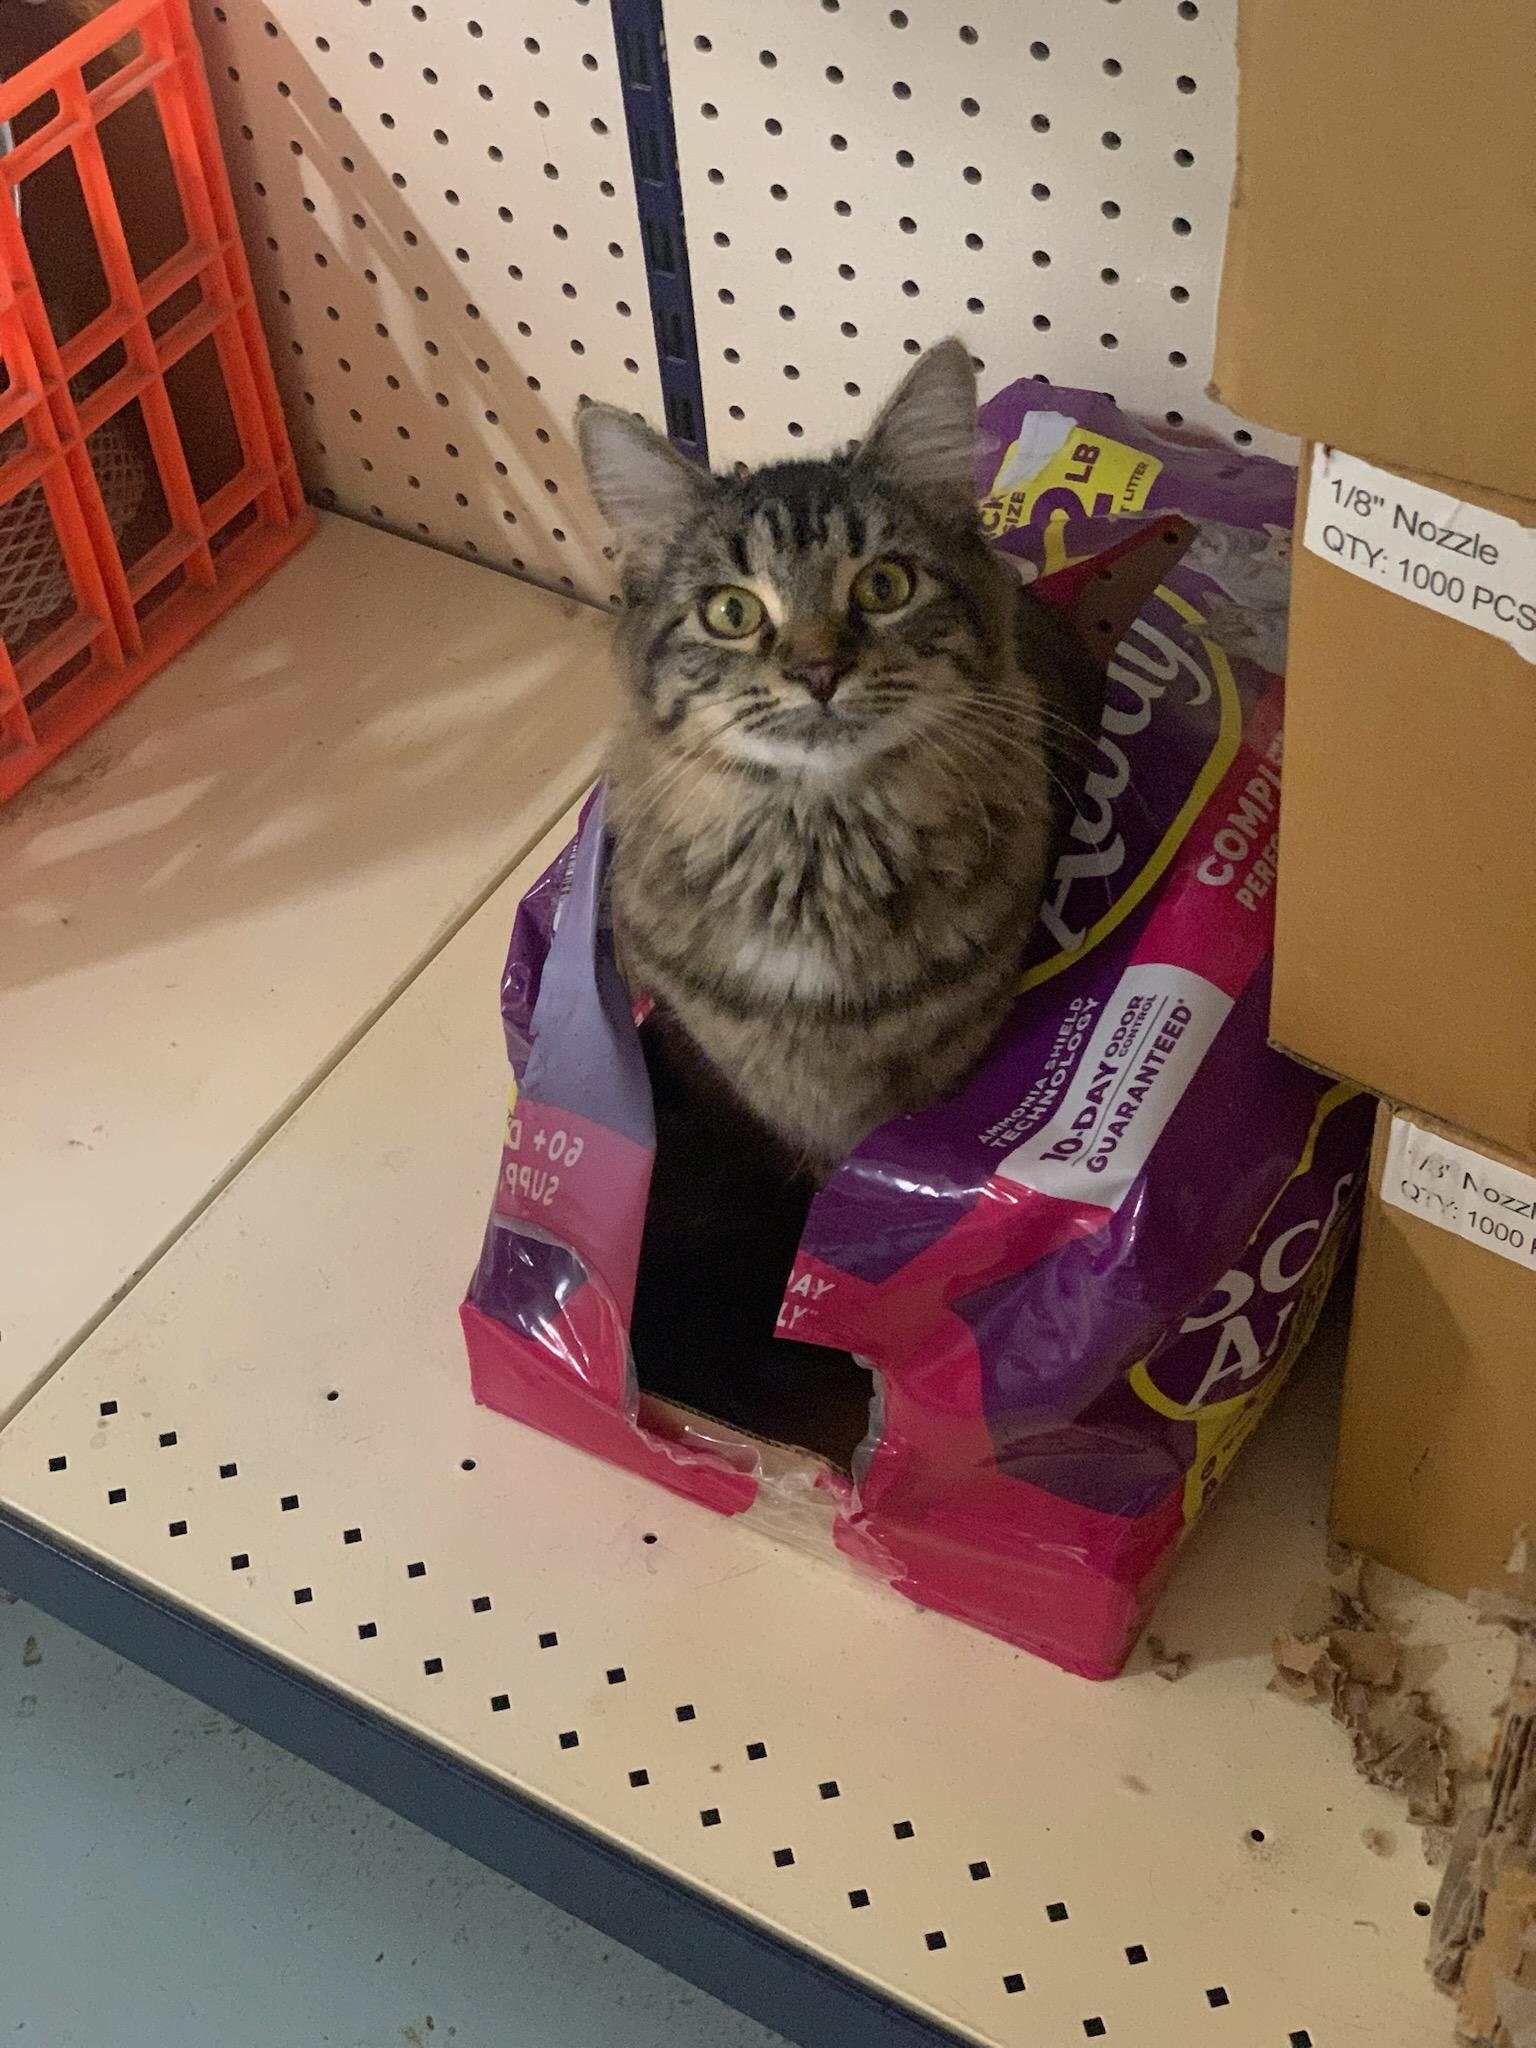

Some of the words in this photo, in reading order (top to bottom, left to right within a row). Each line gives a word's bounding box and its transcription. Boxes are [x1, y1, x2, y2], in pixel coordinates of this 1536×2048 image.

[1064, 443, 1101, 484] LB
[1123, 461, 1150, 502] LITTER
[1331, 478, 1385, 517] 1/8"
[1392, 503, 1499, 566] Nozzle
[1322, 524, 1388, 575] QTY:
[1398, 558, 1465, 604] 1000
[1472, 585, 1536, 632] PCS
[1118, 994, 1158, 1058] CONTROL
[977, 1077, 1047, 1144] AMMONIA
[1044, 997, 1084, 1071] SHIELD
[990, 997, 1099, 1148] TECHNOLOGY
[1039, 1061, 1119, 1162] 10-DAY
[1104, 995, 1144, 1059] ODOR
[1467, 1210, 1524, 1249] 1000
[787, 1269, 836, 1300] AY
